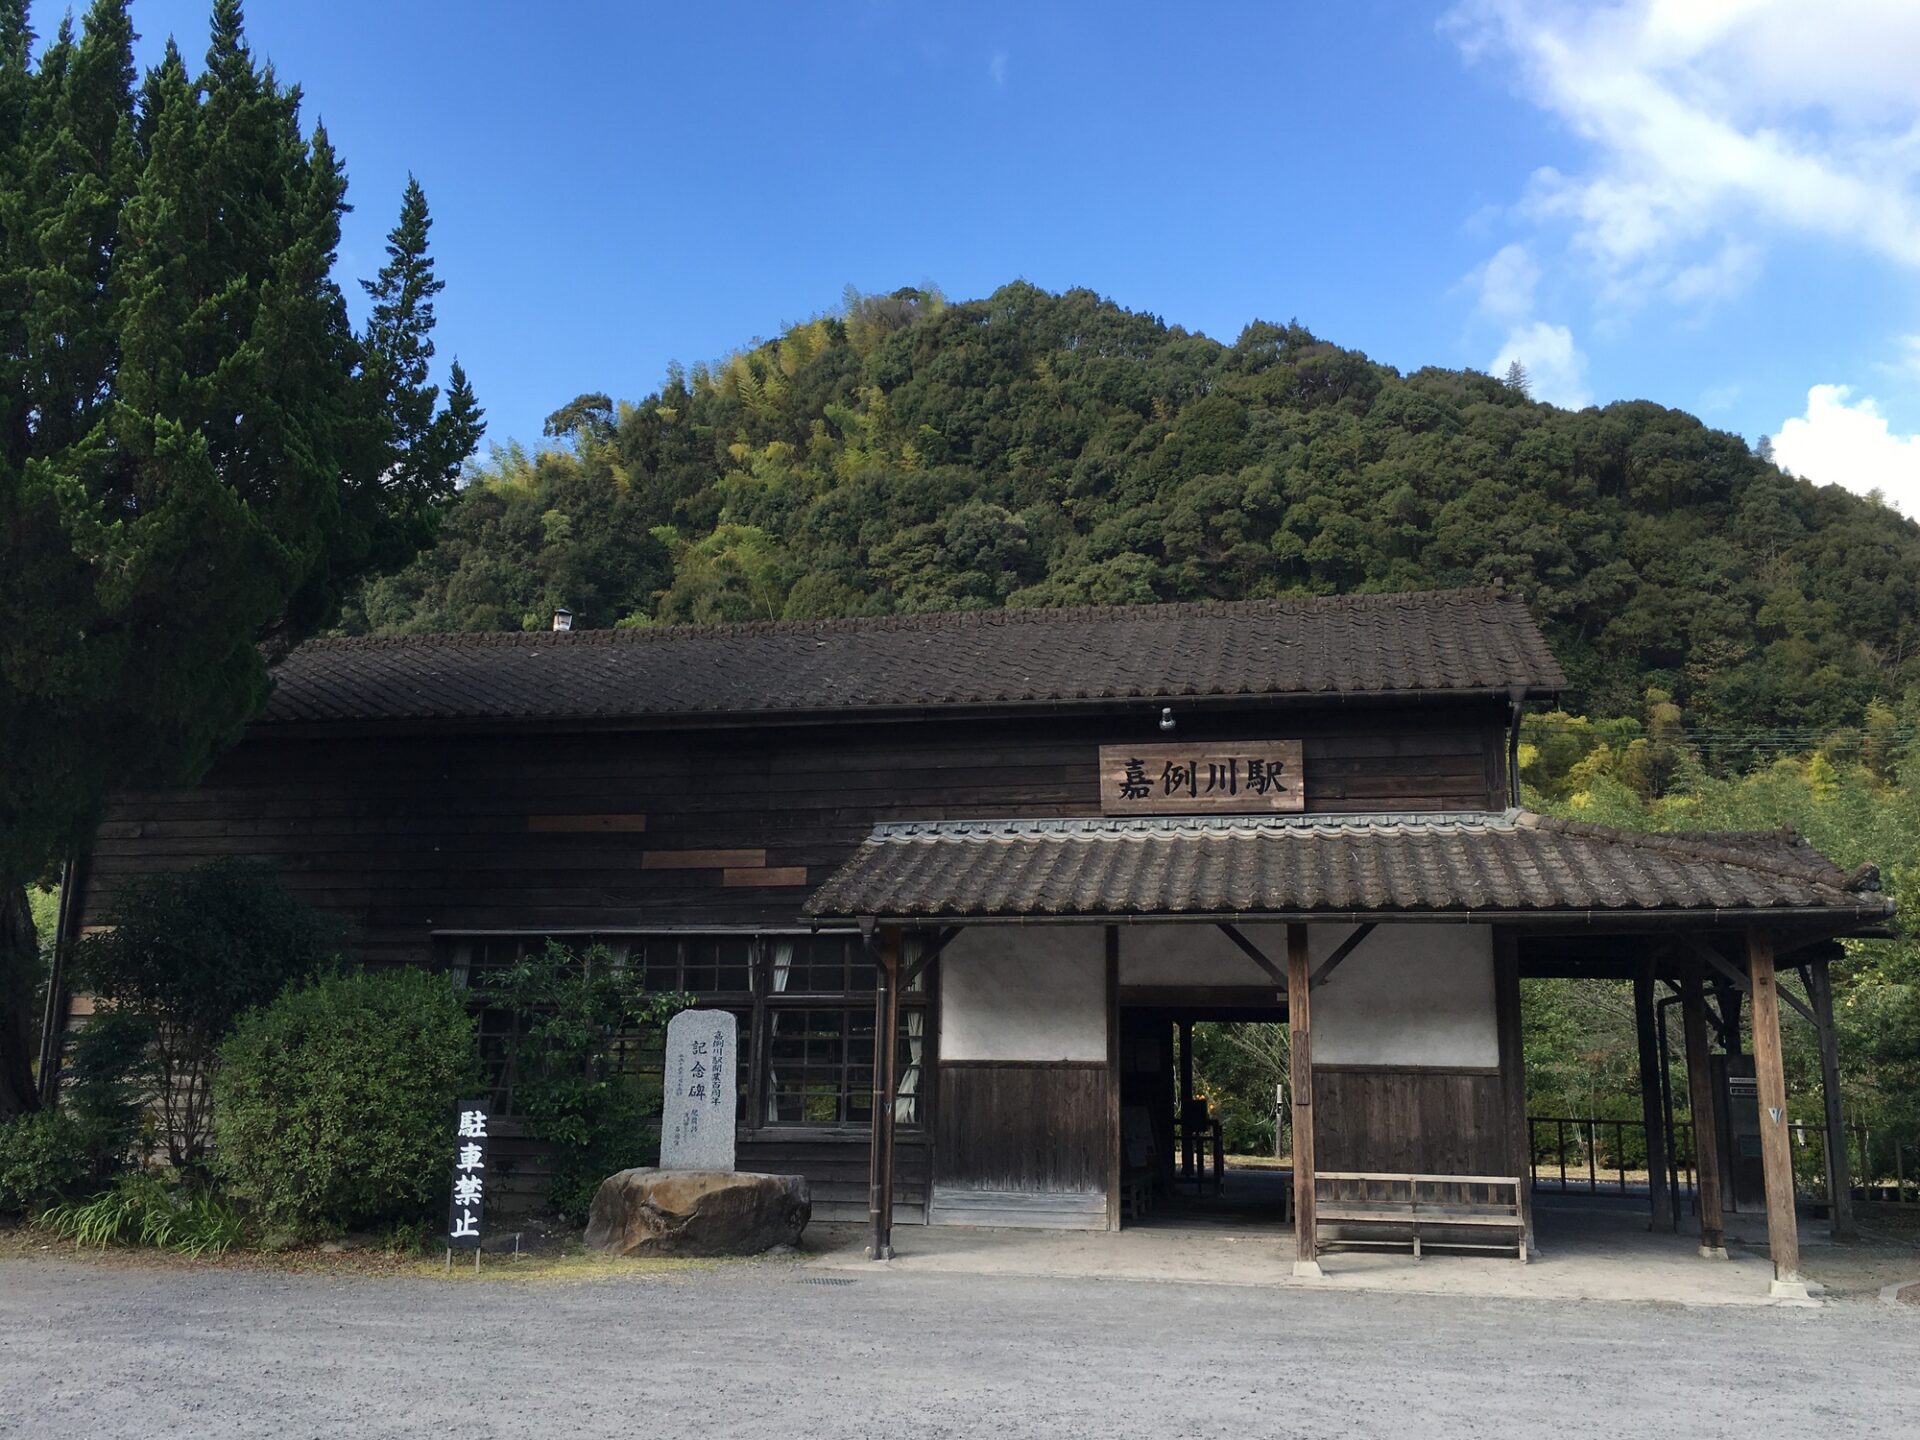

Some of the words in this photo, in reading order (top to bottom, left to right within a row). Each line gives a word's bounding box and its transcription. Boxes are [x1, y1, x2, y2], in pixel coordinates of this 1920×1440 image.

[1118, 758, 1288, 800] 嘉例川駅
[688, 1040, 708, 1101] 記念碑
[450, 1110, 488, 1238] 駐車禁止
